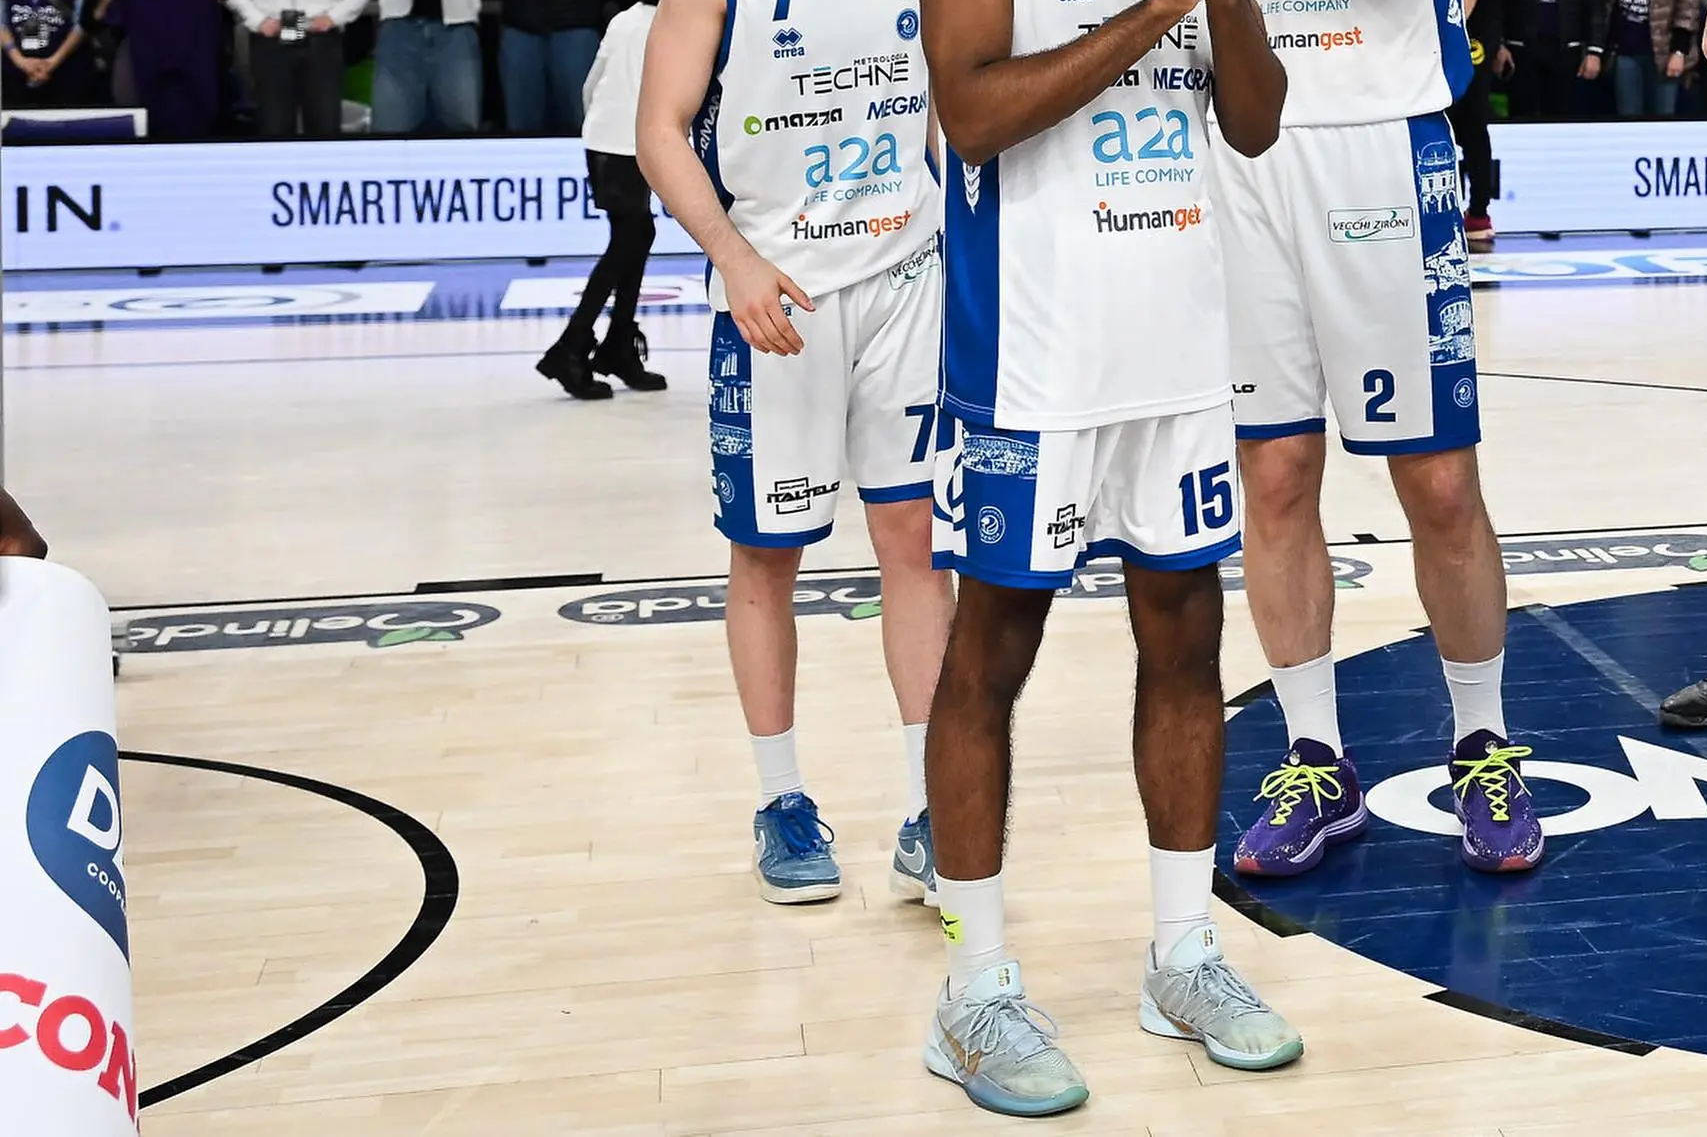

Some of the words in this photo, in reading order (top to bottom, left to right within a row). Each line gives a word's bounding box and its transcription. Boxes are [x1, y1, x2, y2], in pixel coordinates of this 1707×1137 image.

[1268, 26, 1363, 50] umangest
[792, 61, 909, 96] TECHNE
[805, 132, 903, 188] a2a
[1091, 107, 1195, 163] a2a
[271, 177, 543, 228] SMARTWATCH
[1096, 171, 1130, 188] LIFE
[793, 212, 912, 240] Humangest
[1362, 369, 1397, 423] 2
[904, 404, 936, 463] 7
[1179, 460, 1234, 537] 15
